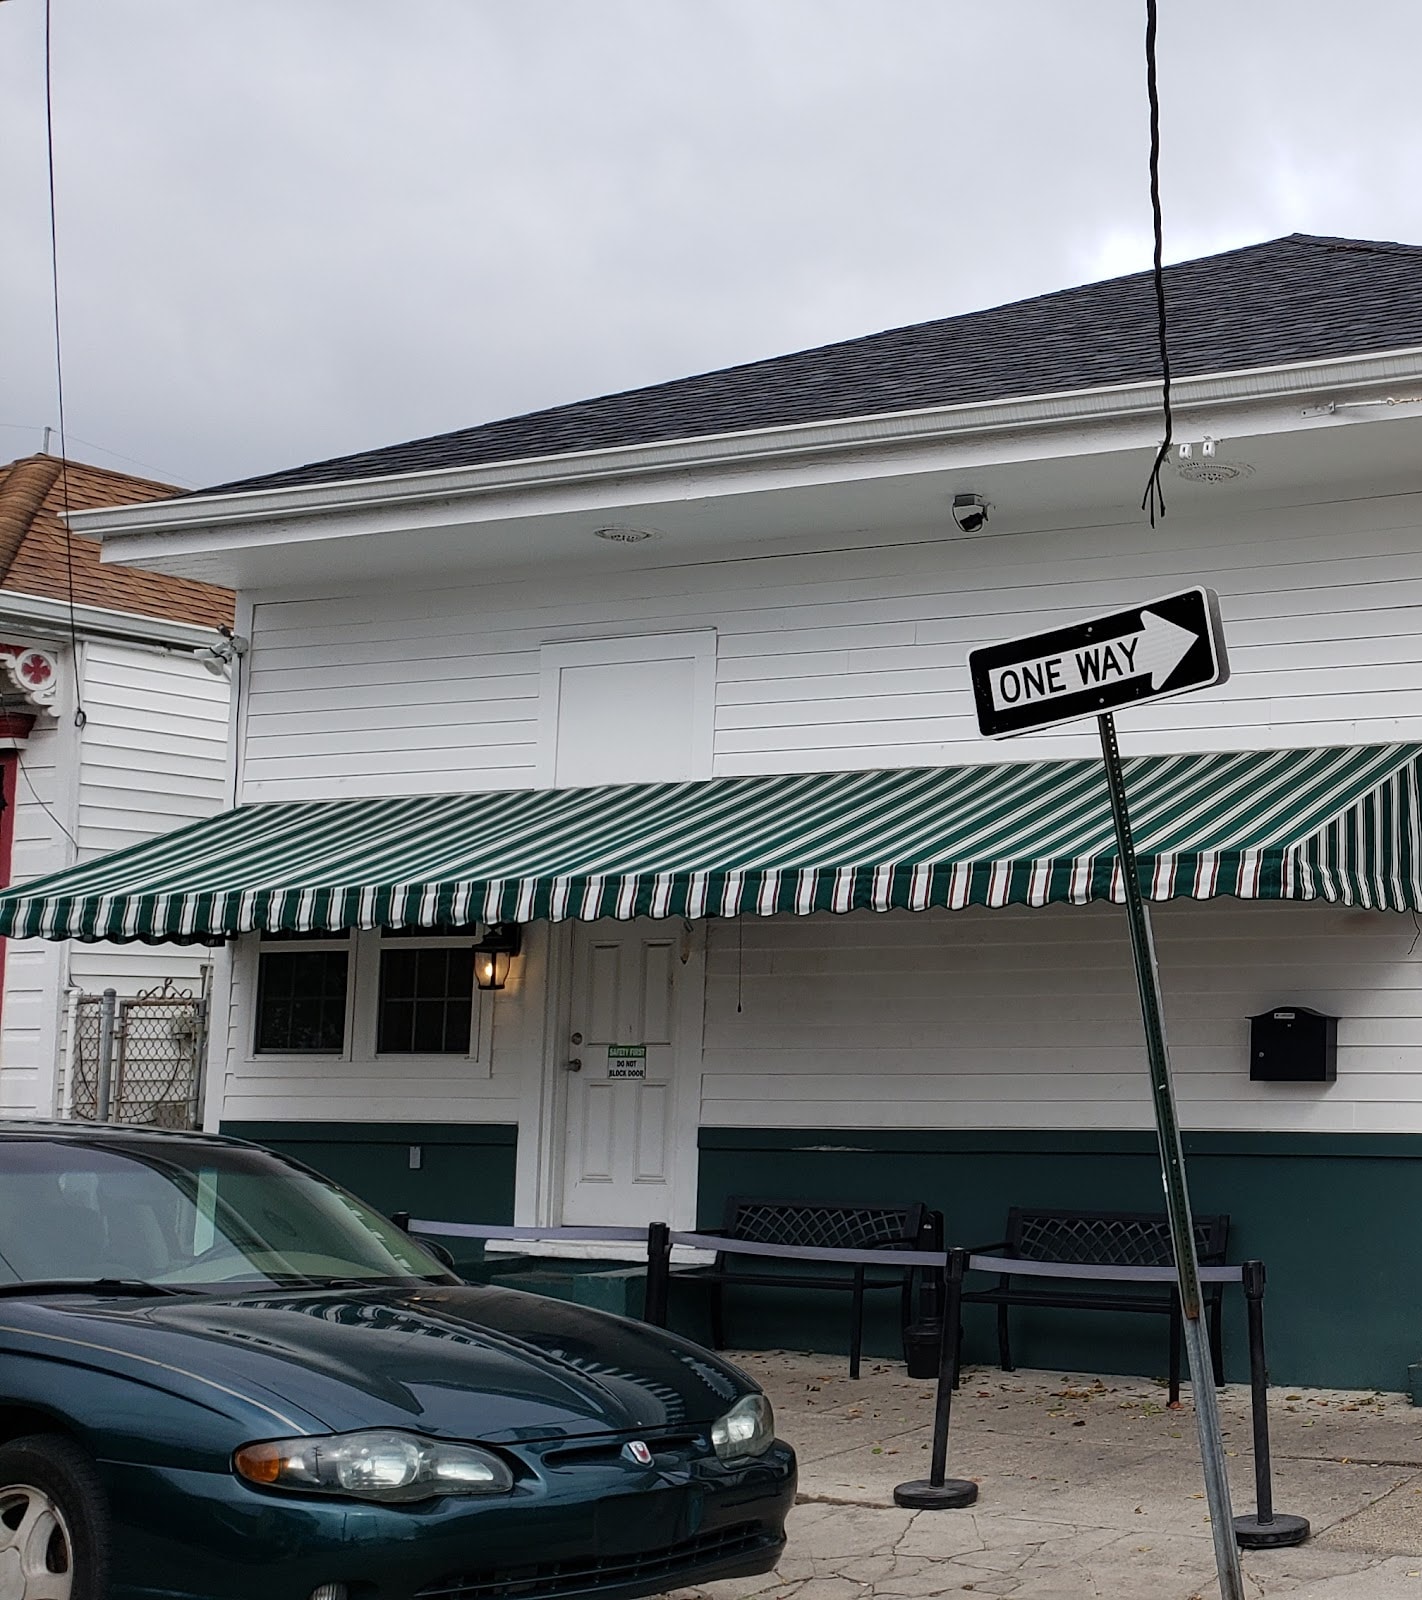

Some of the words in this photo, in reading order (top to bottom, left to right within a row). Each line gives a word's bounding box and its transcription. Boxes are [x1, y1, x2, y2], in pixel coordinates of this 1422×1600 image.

[999, 657, 1067, 704] ONE
[1075, 636, 1140, 686] WAY
[609, 1048, 629, 1056] SAFETY
[629, 1048, 645, 1056] FIRST
[609, 1069, 627, 1077] BLOCK
[628, 1069, 644, 1077] DOOR
